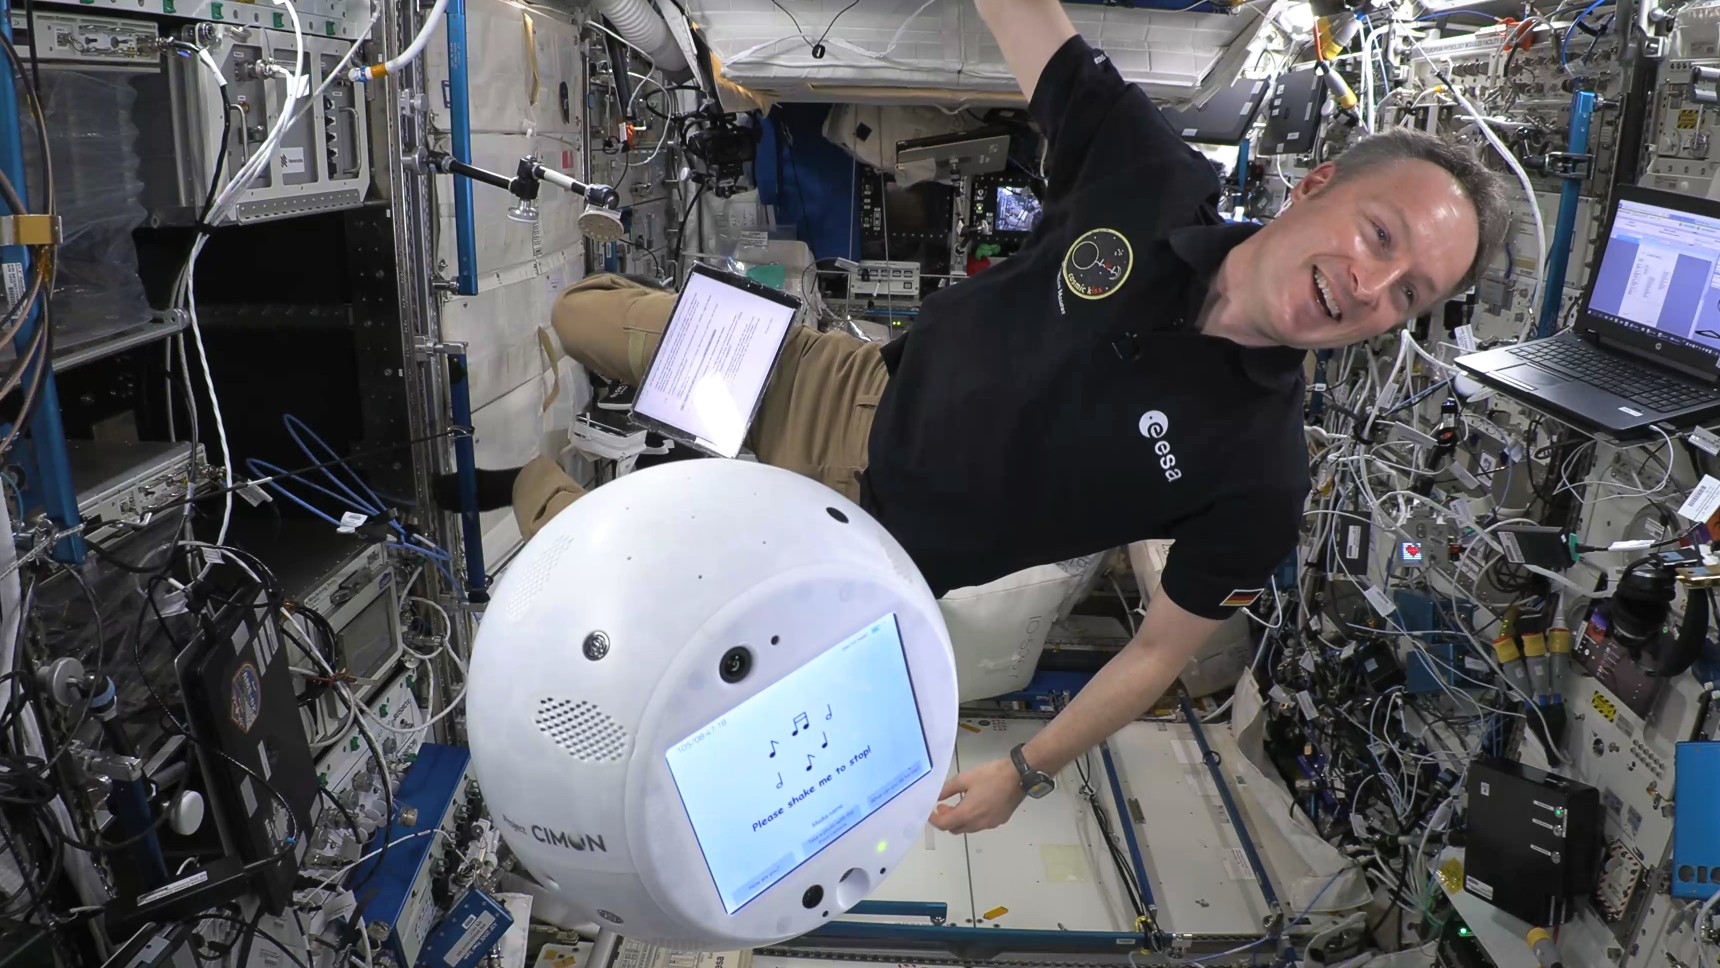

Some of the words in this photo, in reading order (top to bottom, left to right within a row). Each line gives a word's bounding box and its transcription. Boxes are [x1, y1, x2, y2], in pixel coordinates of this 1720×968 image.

[1068, 273, 1086, 293] cosmic
[1087, 286, 1103, 294] kiss
[1155, 441, 1182, 482] esa
[752, 807, 784, 831] Please
[787, 786, 815, 808] shake
[819, 774, 833, 787] me
[835, 763, 847, 774] to
[849, 745, 872, 767] stop!
[812, 814, 829, 827] Media
[829, 804, 843, 816] name
[531, 825, 606, 852] CIMON
